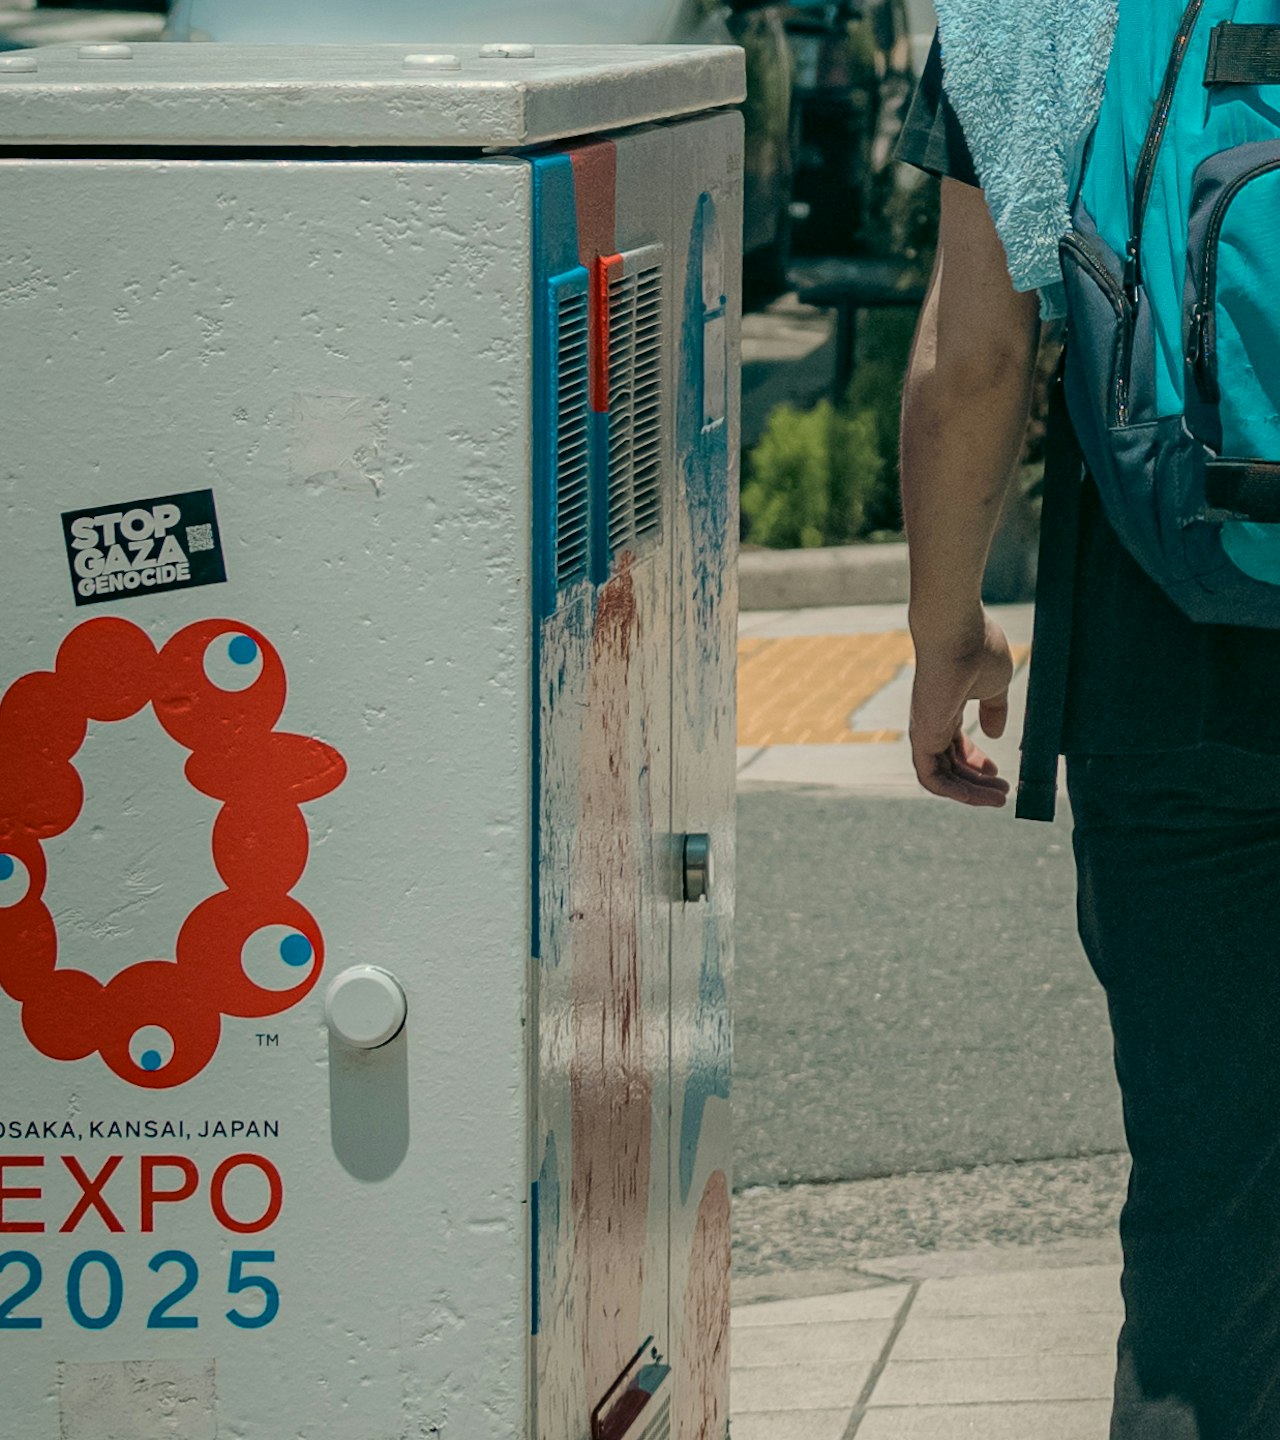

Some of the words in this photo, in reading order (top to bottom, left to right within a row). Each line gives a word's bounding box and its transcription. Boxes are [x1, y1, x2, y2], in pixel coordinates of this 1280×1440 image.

[70, 503, 181, 550] STOP
[74, 534, 189, 579] GAZA
[77, 562, 191, 597] GENOCIDE
[255, 1034, 279, 1047] TM
[90, 1120, 191, 1140] KANSAI,
[198, 1120, 279, 1138] JAPAN
[0, 1152, 284, 1234] EXPO
[0, 1249, 280, 1330] 2025
